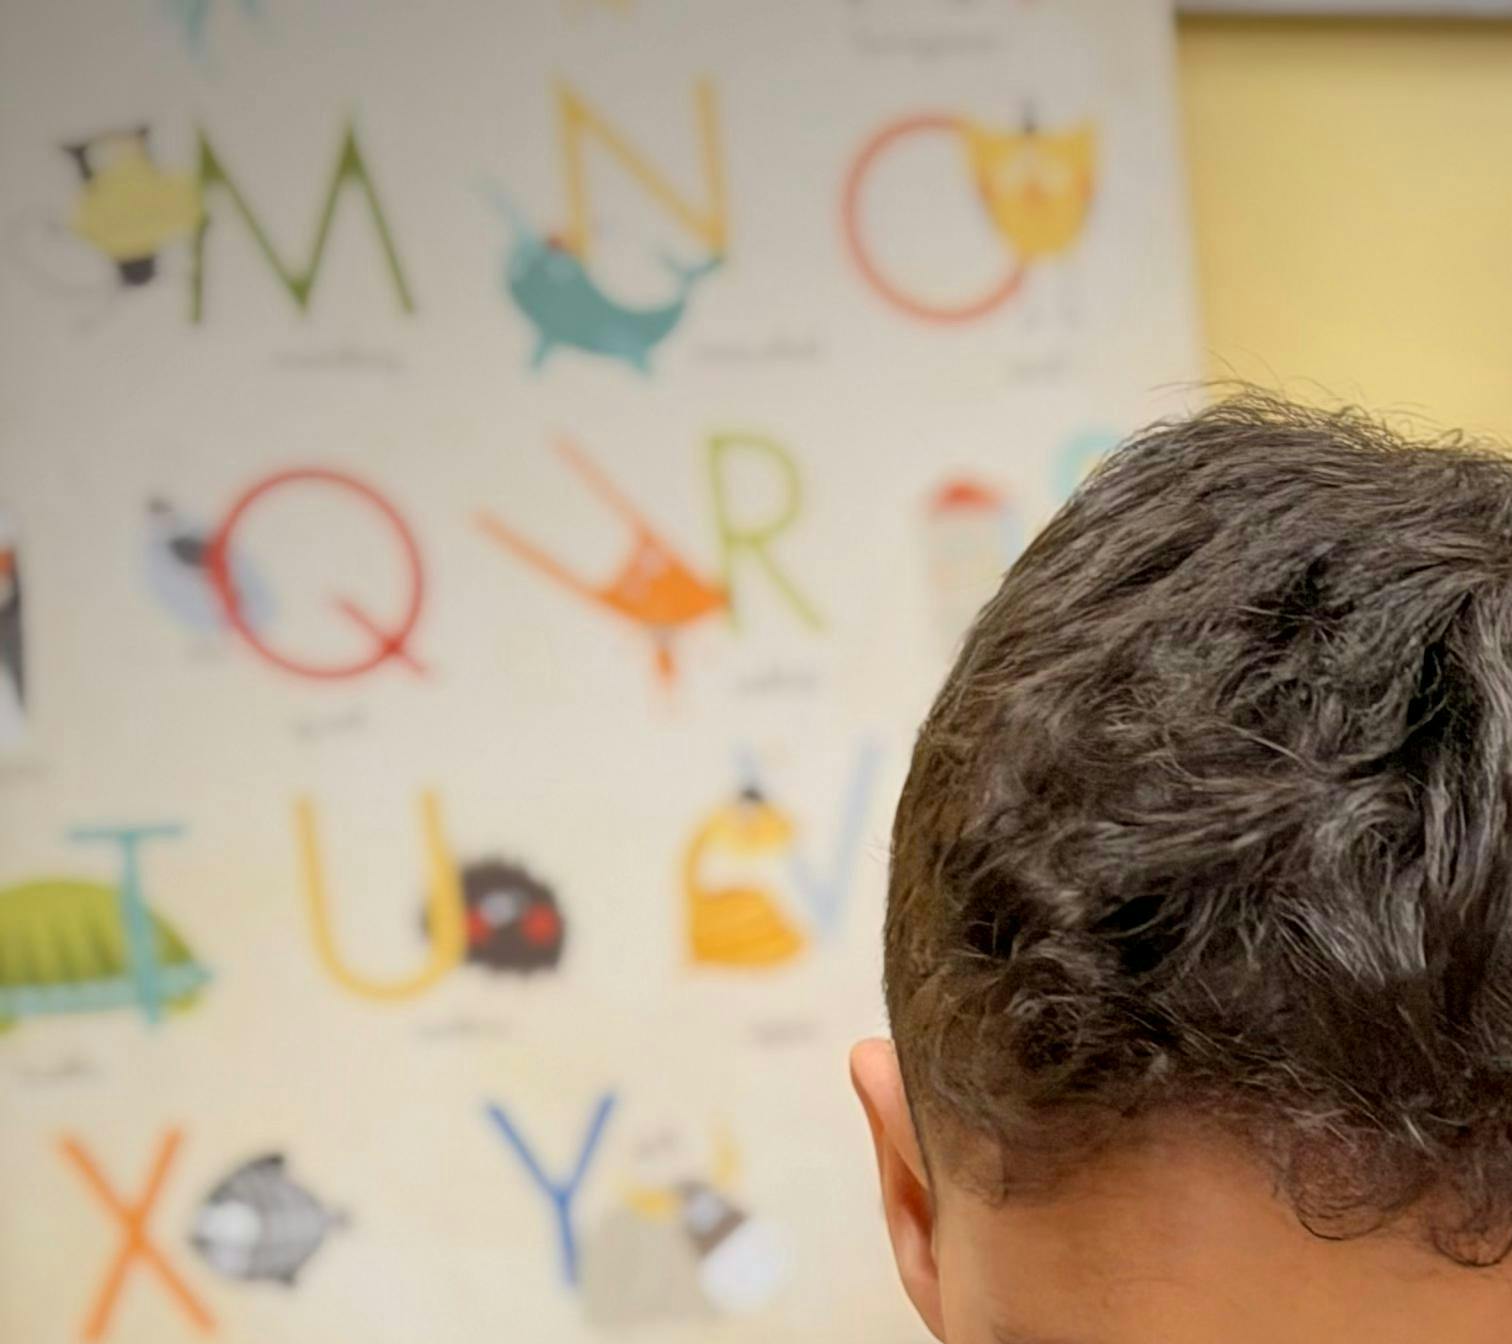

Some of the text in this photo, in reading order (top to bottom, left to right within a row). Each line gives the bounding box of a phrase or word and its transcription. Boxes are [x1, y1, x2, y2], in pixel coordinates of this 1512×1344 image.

[186, 121, 417, 326] M
[551, 74, 731, 264] N
[202, 428, 828, 683] Q R
[296, 791, 468, 1002] U
[484, 1090, 619, 1286] Y
